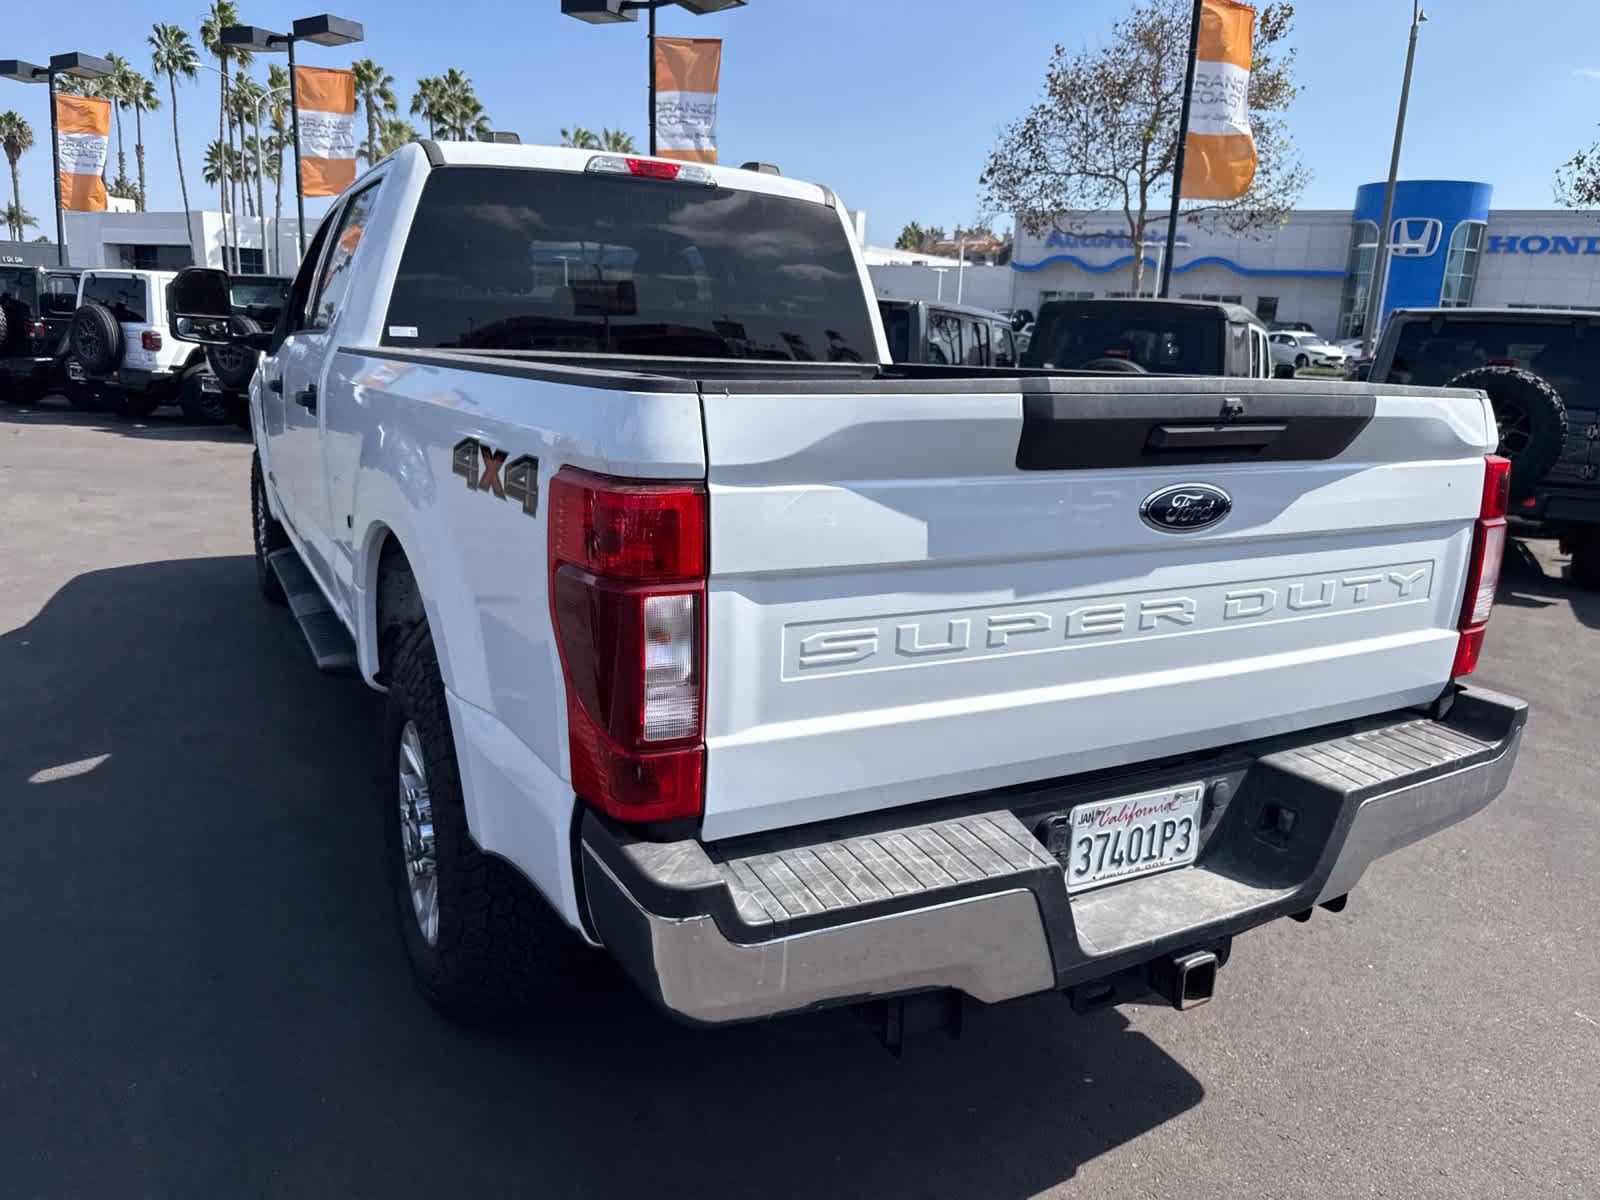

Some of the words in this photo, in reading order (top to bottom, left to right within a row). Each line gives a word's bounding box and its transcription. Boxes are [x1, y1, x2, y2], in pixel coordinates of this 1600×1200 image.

[1165, 493, 1217, 524] Ford
[798, 597, 1197, 668] SUPER
[1223, 566, 1427, 620] DUTY
[1078, 809, 1096, 825] JAN
[1097, 798, 1180, 828] California
[1074, 817, 1193, 877] 37401P3
